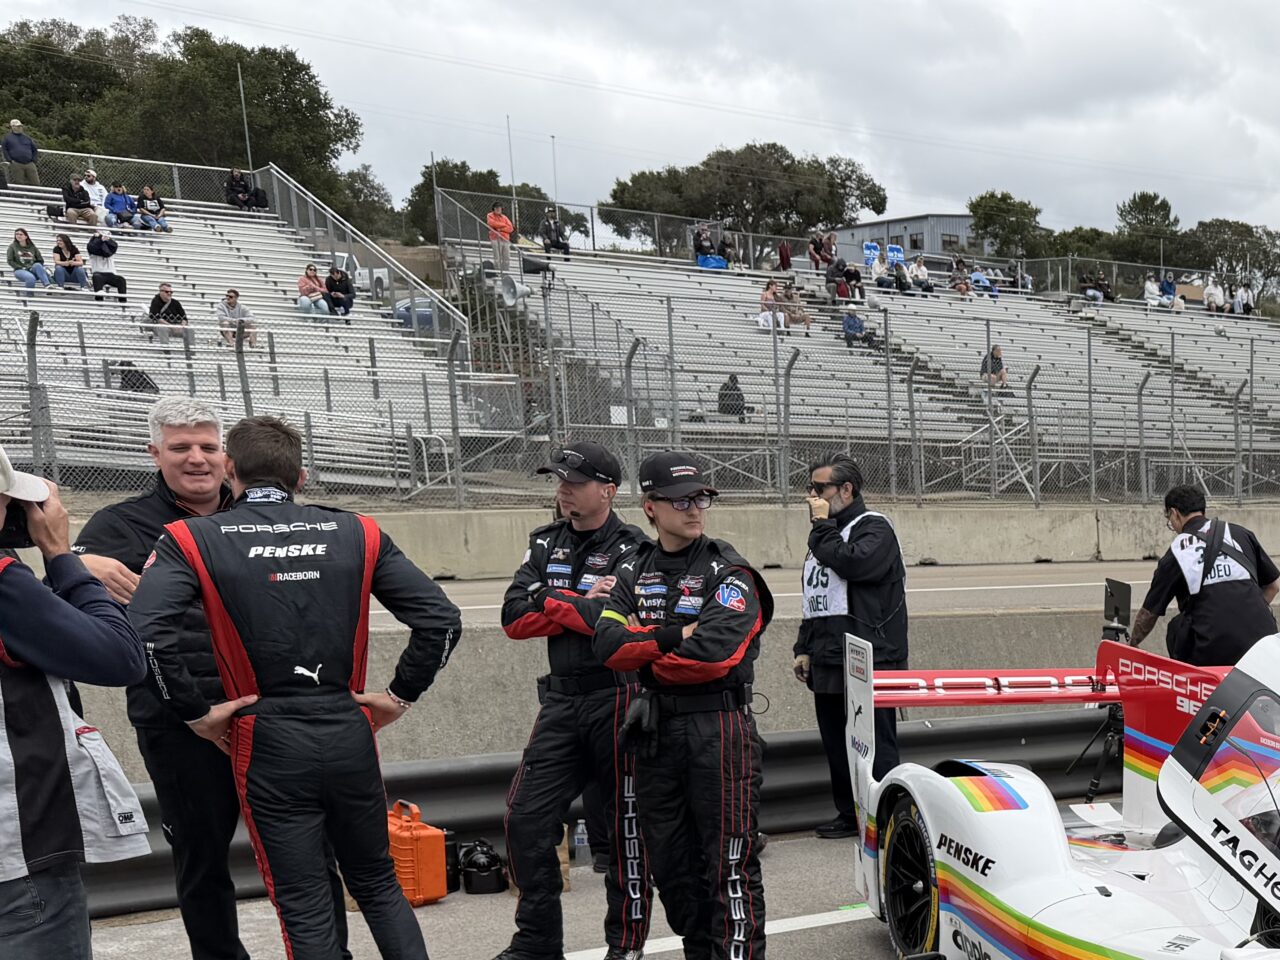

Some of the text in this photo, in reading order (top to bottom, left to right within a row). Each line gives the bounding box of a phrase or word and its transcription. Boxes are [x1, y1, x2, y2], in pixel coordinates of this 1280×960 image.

[220, 521, 339, 534] PORSCHE
[248, 544, 328, 558] PENSKE
[276, 570, 320, 582] RACEBORN
[638, 597, 666, 607] Ansys
[720, 584, 741, 606] VP
[146, 642, 171, 700] PORSCHE
[117, 813, 134, 823] OMP
[624, 775, 644, 920] PORSCHE
[936, 833, 996, 878] PENSKE
